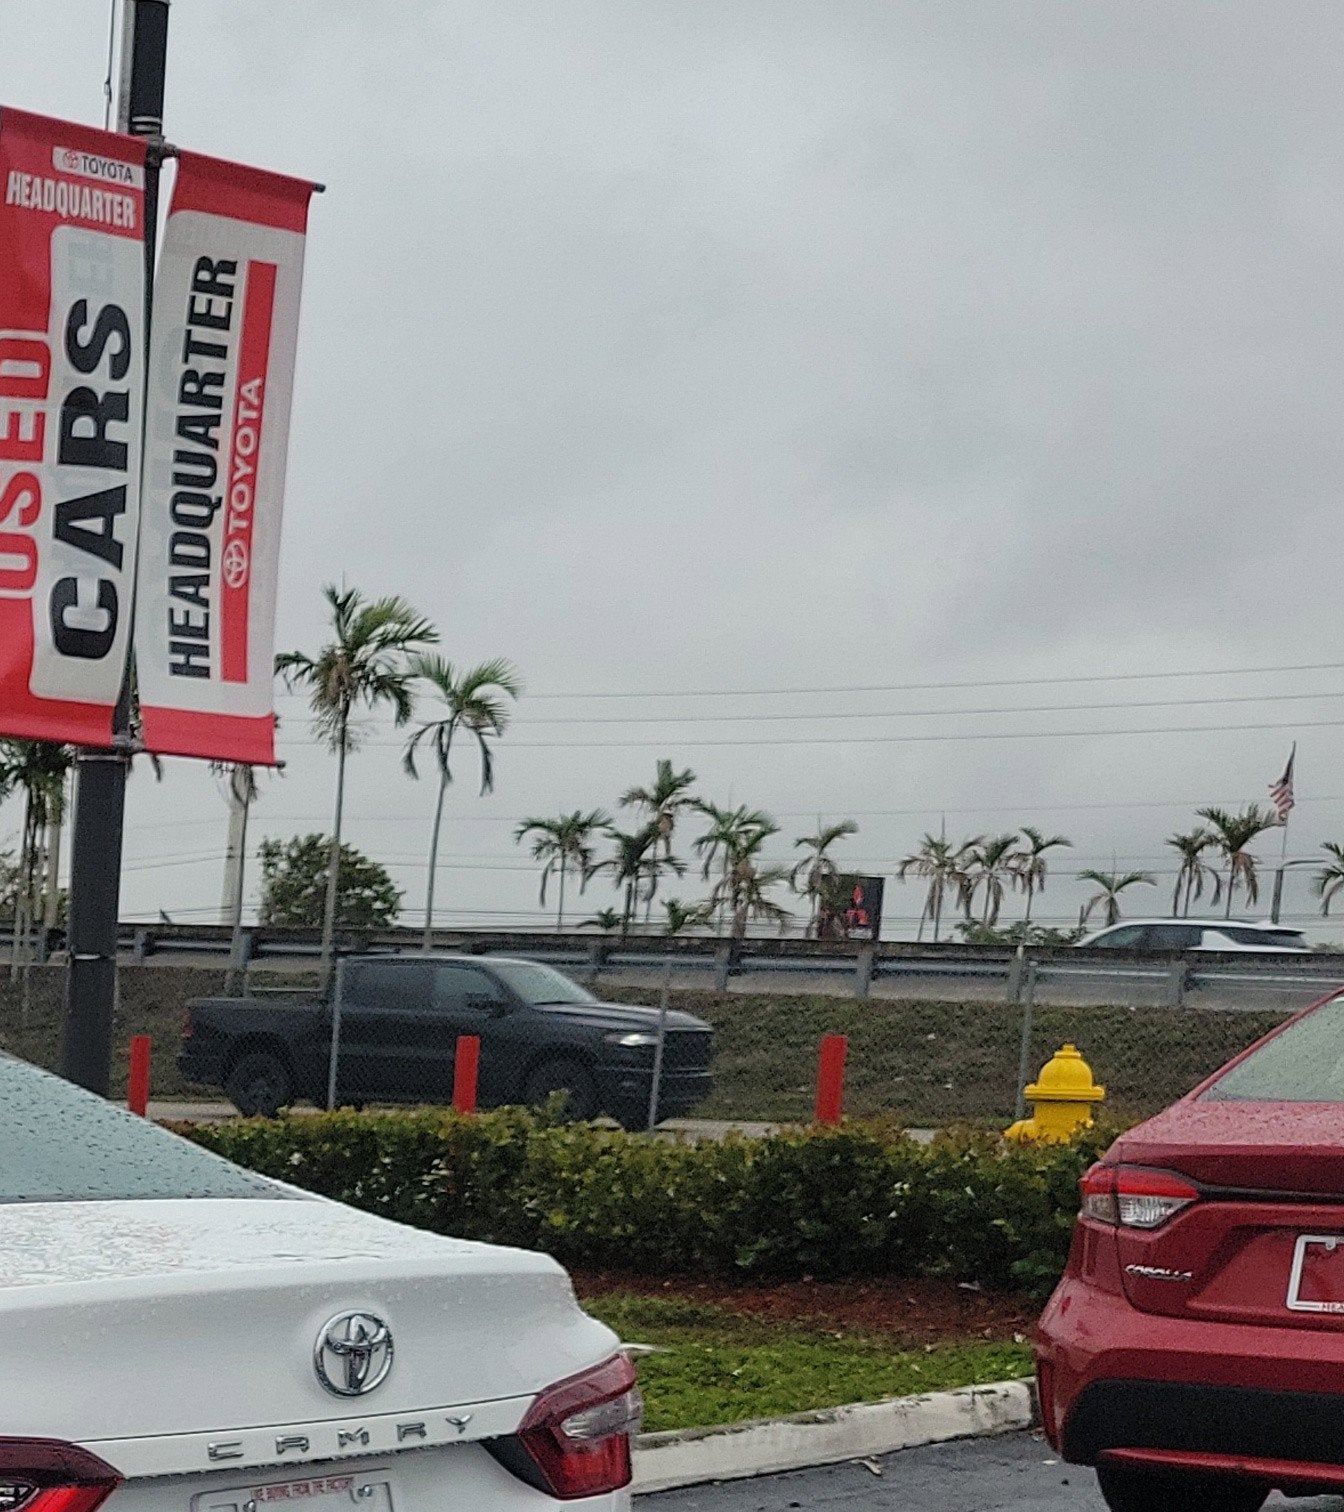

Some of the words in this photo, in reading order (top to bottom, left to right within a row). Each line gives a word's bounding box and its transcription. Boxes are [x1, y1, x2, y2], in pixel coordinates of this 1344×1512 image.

[6, 171, 136, 229] HEADQUARTER
[81, 155, 133, 183] TOYOTA
[50, 298, 131, 659] CARS
[168, 256, 238, 679] HEADQUARTER
[229, 378, 264, 534] TOYOTA
[207, 1415, 472, 1461] CAMRY
